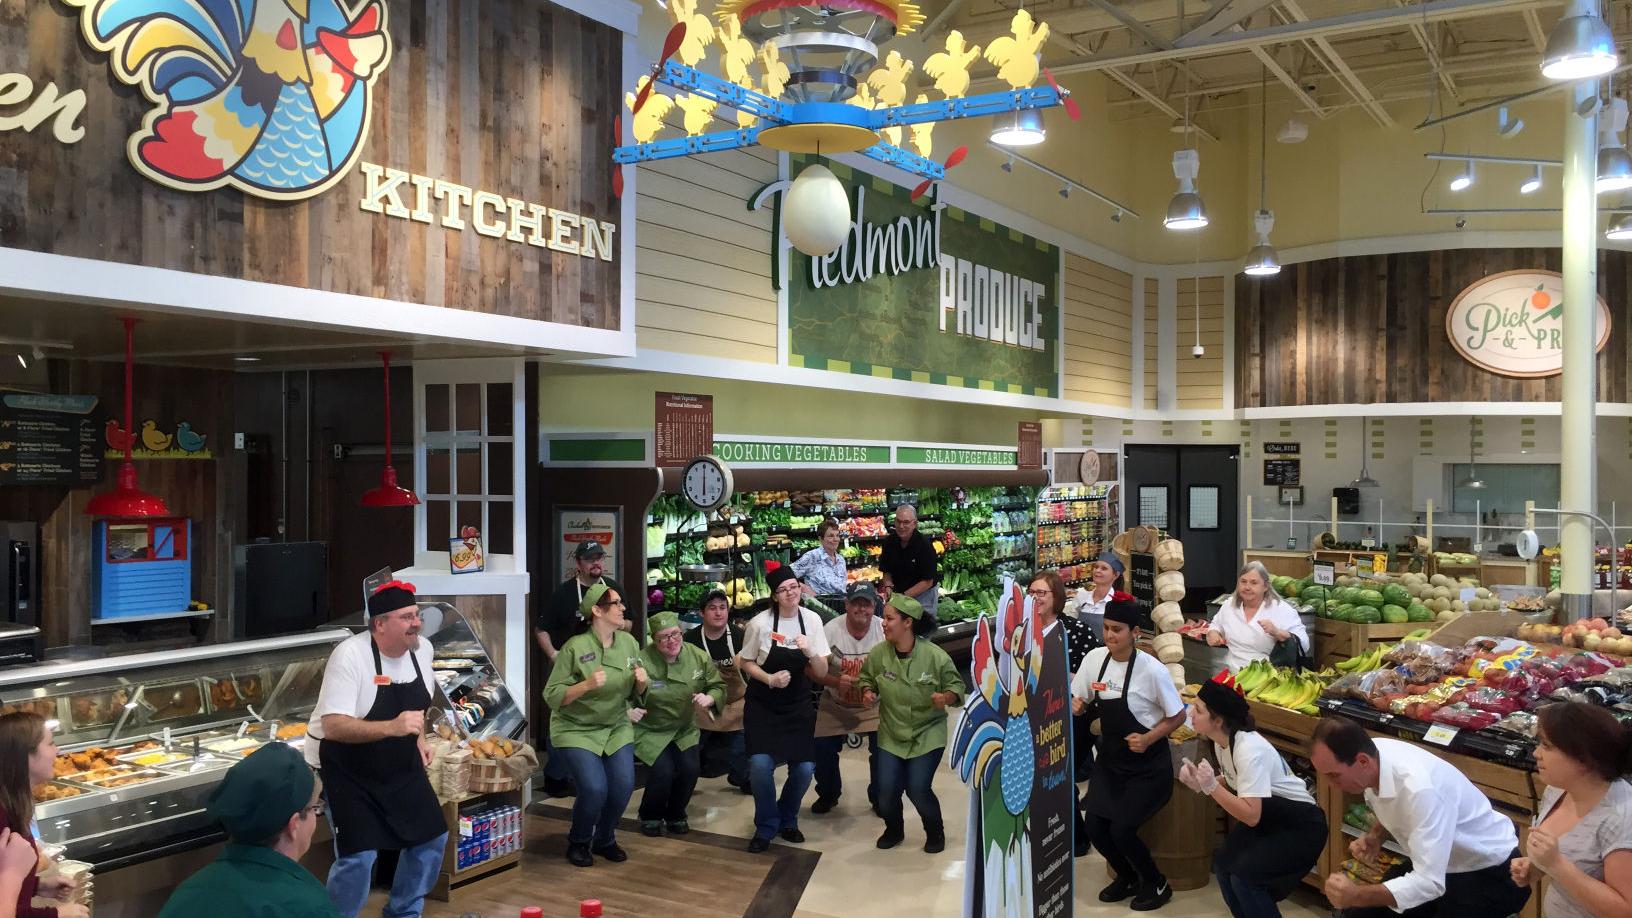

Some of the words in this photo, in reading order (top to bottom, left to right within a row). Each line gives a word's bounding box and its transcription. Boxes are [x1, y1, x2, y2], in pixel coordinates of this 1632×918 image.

[360, 161, 616, 262] KITCHEN
[938, 252, 1046, 352] PRODUCE
[1465, 297, 1534, 350] Pick
[712, 443, 781, 461] COOKING
[785, 445, 867, 462] VEGETABLES
[925, 449, 957, 464] SALAD
[958, 450, 1014, 465] VEGETABLES
[1039, 719, 1063, 746] better
[1049, 736, 1066, 766] bird
